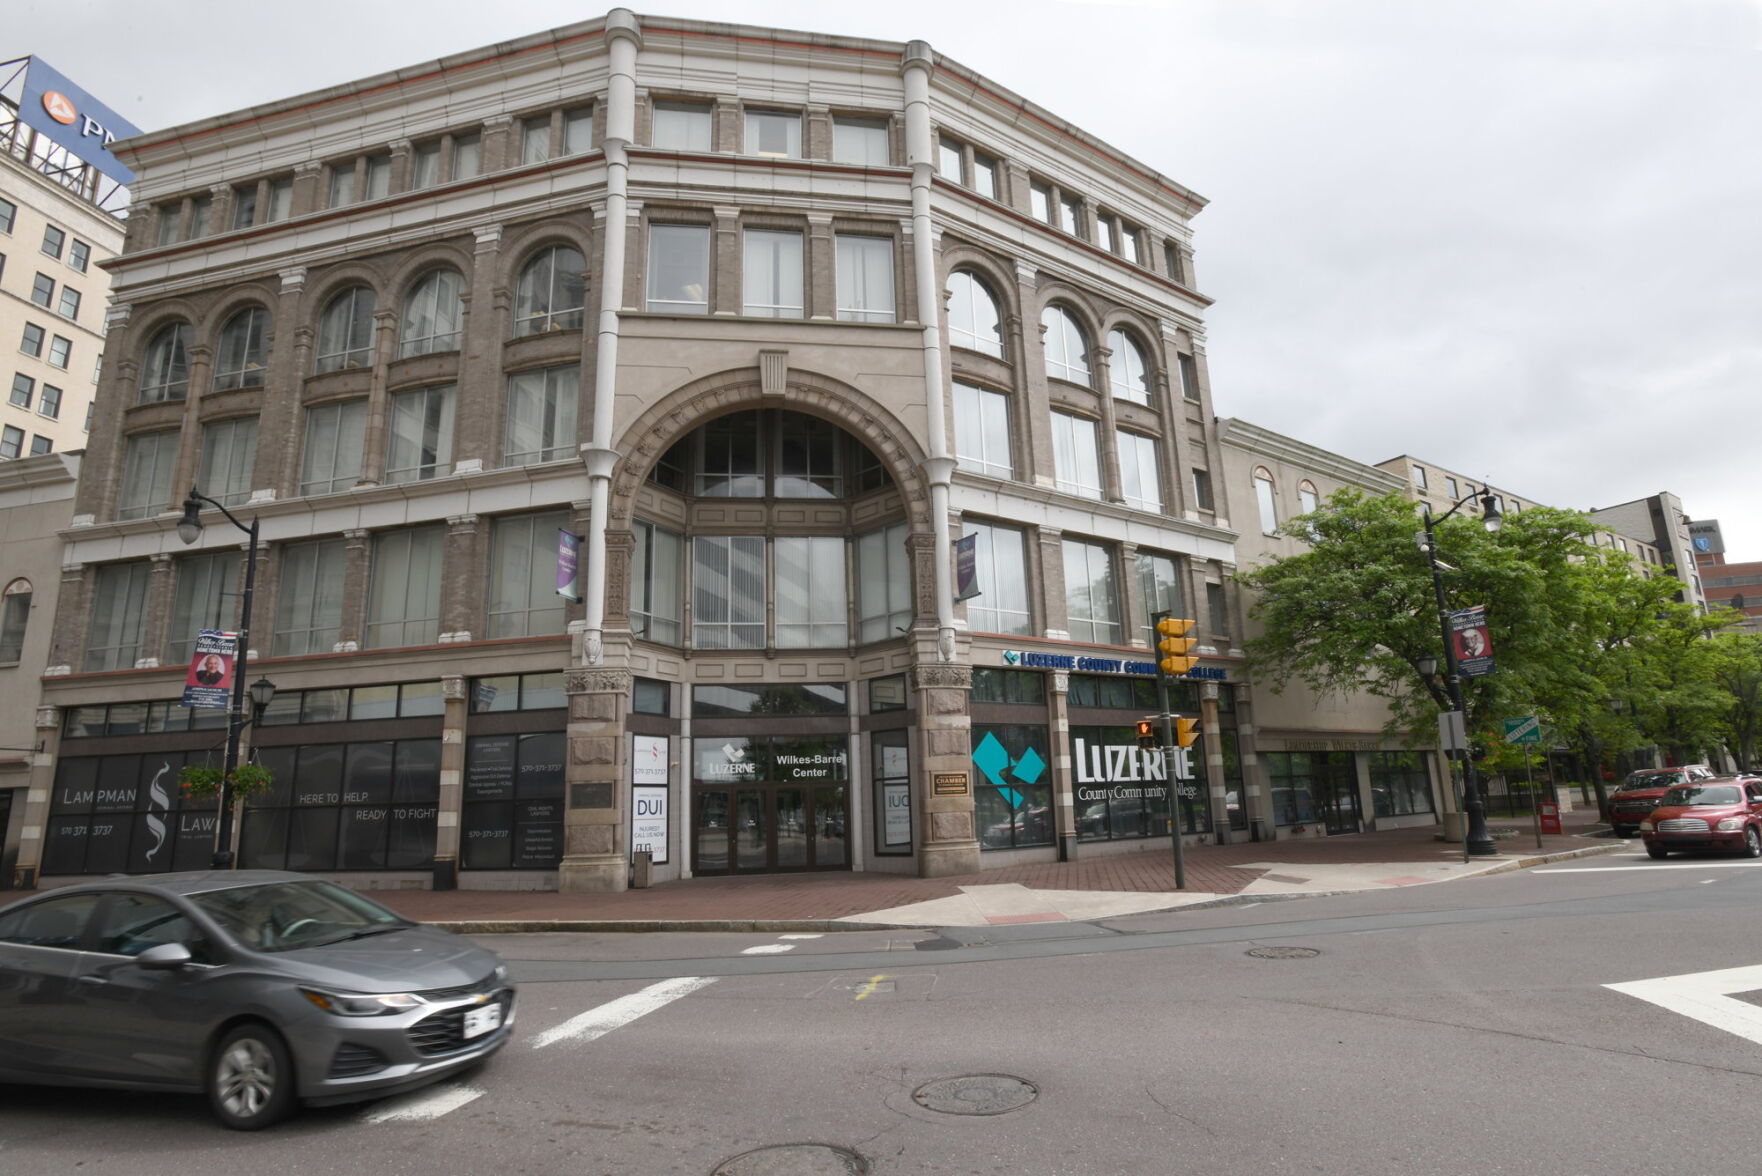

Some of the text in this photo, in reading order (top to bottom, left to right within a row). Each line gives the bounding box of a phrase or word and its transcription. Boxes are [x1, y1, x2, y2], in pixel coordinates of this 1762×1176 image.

[1020, 652, 1076, 669] LUZERNE
[1077, 657, 1122, 673] COUNTY
[777, 754, 842, 765] Wilkes-Barre
[709, 762, 756, 775] LUZERNE
[793, 767, 828, 778] Center
[63, 787, 137, 804] LAMPMAN
[300, 793, 324, 804] HERE
[326, 793, 339, 804] TO
[1078, 786, 1114, 801] County
[356, 808, 437, 821] READY TO FIGHT
[637, 799, 663, 816] DUI
[181, 815, 215, 832] LAW
